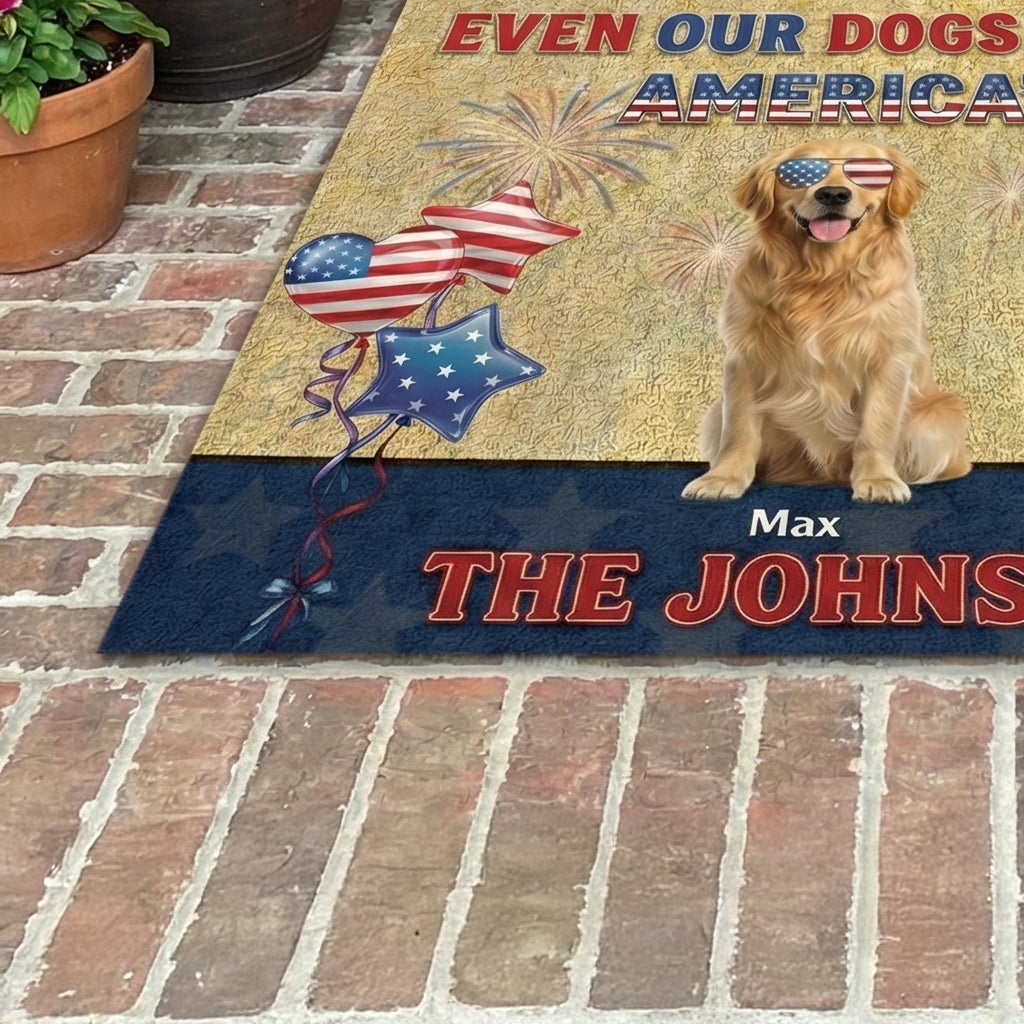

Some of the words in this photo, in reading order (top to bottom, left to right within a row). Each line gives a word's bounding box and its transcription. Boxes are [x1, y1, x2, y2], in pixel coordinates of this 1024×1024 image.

[439, 12, 639, 54] EVEN
[656, 12, 805, 54] OUR
[826, 12, 1021, 54] DOGS
[748, 508, 841, 539] Max
[422, 550, 640, 625] THE
